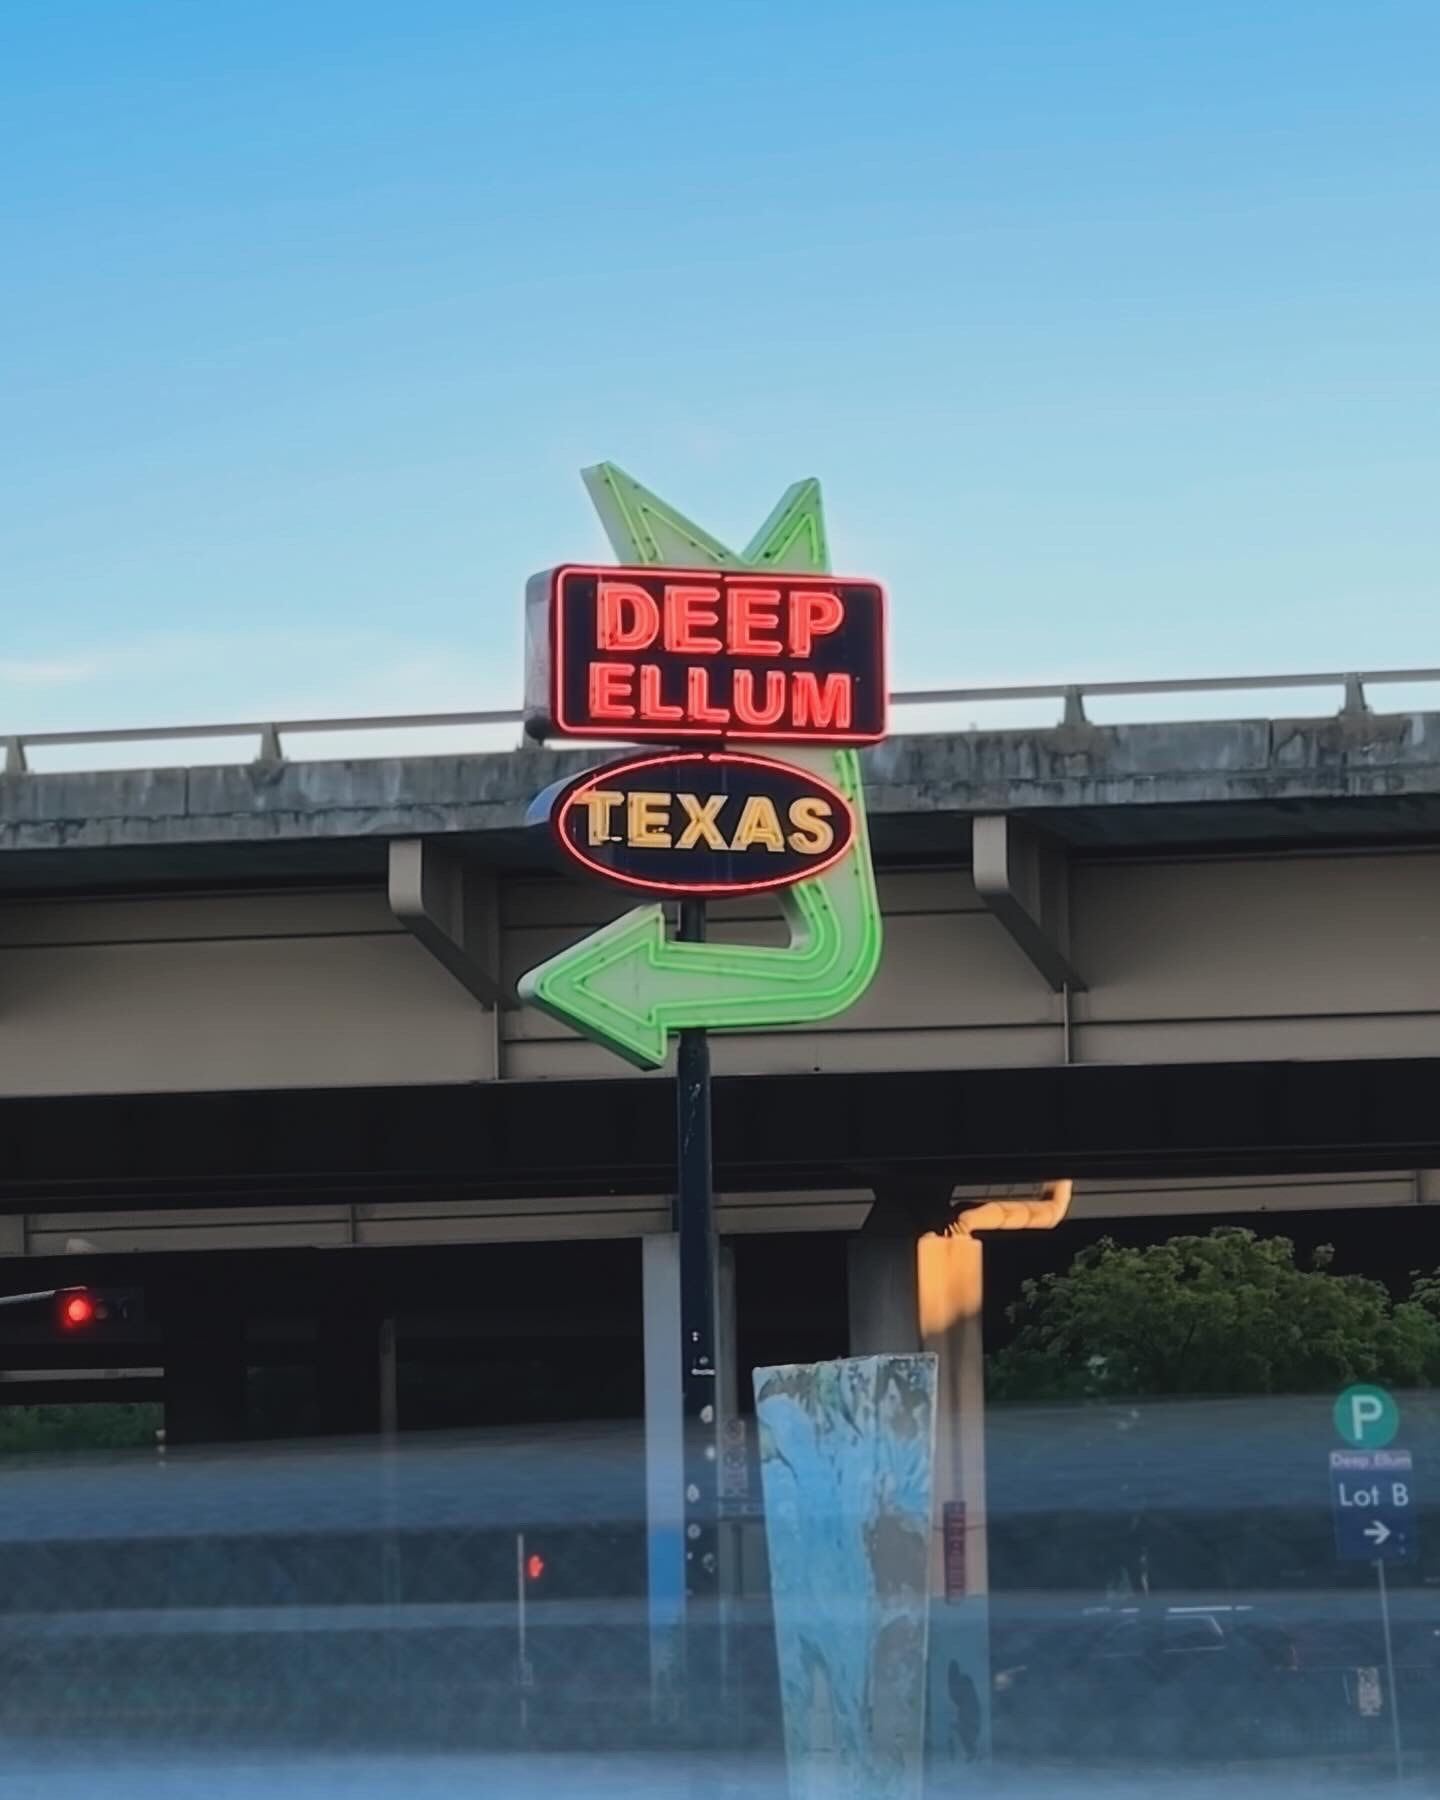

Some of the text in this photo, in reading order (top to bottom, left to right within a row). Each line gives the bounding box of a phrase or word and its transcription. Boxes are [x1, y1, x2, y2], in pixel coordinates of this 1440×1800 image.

[597, 582, 845, 658] DEEP
[589, 662, 852, 729] ELLUM
[573, 790, 835, 855] TEXAS
[1351, 1395, 1382, 1440] P
[1338, 1482, 1409, 1507] Lot B
